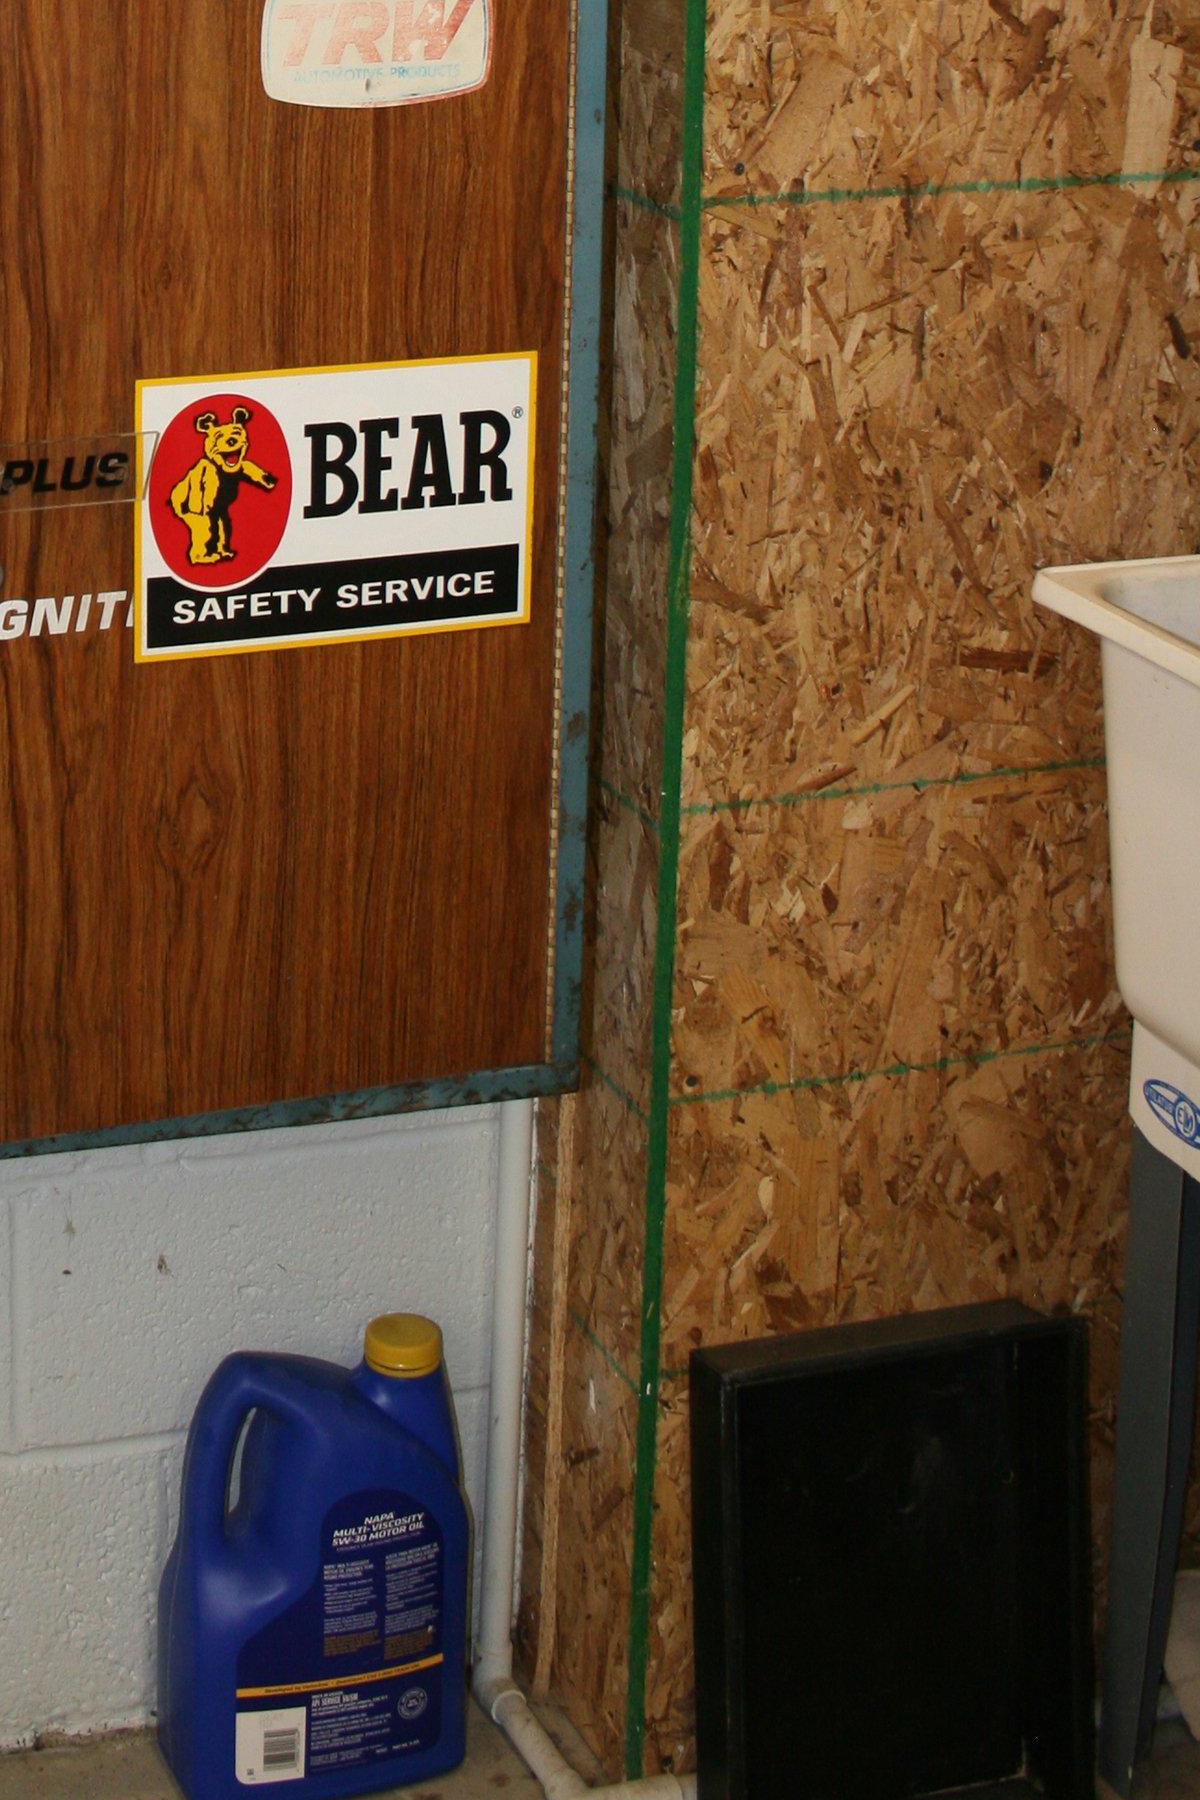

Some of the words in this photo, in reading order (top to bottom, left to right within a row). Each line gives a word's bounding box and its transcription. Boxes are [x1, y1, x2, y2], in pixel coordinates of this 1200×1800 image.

[293, 67, 384, 84] AUTOMOTIVE
[390, 63, 460, 79] PRODUCTS
[0, 452, 129, 496] PLUS
[303, 408, 513, 520] BEAR
[172, 588, 321, 625] SAFETY
[335, 570, 495, 609] SERVICE
[331, 1535, 367, 1547] 5W-30
[368, 1526, 407, 1542] MOTOR
[408, 1520, 425, 1532] OIL
[363, 1511, 395, 1526] NAPA
